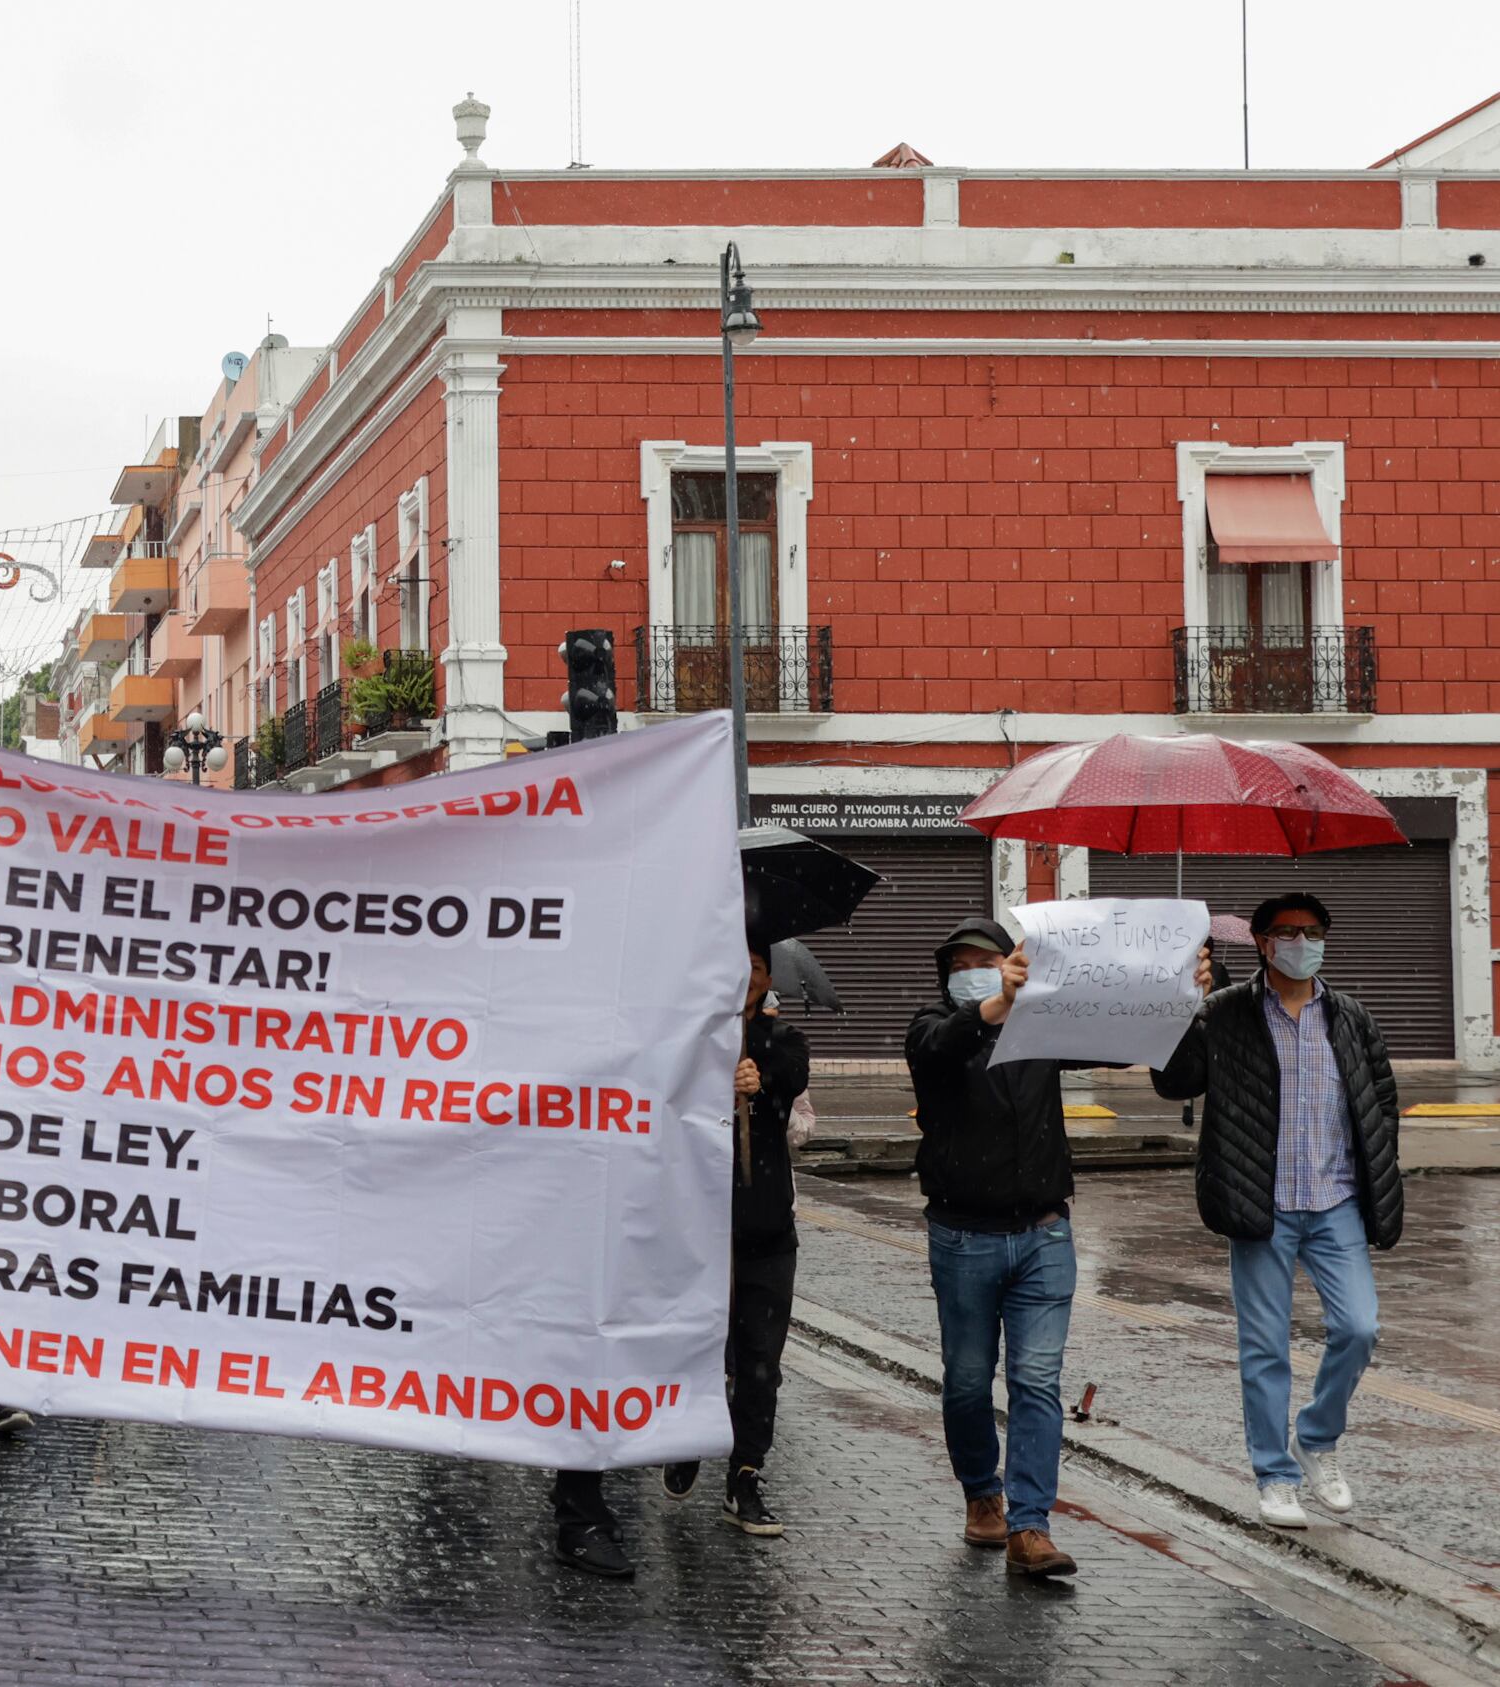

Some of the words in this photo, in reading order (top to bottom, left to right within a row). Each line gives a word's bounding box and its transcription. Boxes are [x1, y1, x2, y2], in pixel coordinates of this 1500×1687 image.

[231, 777, 582, 828] ORTOPEDIA
[754, 817, 789, 827] VENTA
[791, 817, 805, 827] DE
[807, 817, 838, 828] LONA
[840, 817, 847, 827] Y
[850, 817, 909, 828] ALFOMBRA
[771, 803, 799, 814] SIMIL
[800, 803, 838, 815] CUERO
[844, 804, 901, 815] PLYMOUTH
[902, 804, 924, 815] S.A.
[927, 805, 941, 815] DE
[47, 811, 230, 866] VALLE
[6, 867, 84, 912] EN
[103, 876, 170, 920] EL
[190, 884, 468, 937] PROCESO
[487, 898, 564, 939] DE
[1113, 911, 1192, 951] FUIMOS
[1140, 964, 1184, 995] HOY
[1032, 999, 1100, 1017] SOMOS
[103, 1049, 272, 1110] AÑOS
[291, 1072, 385, 1117] SIN
[401, 1079, 651, 1134] RECIBIR:
[81, 1120, 199, 1171] LEY.
[119, 1263, 412, 1332] FAMILIAS.
[121, 1341, 199, 1389] EN
[218, 1352, 285, 1398] EL
